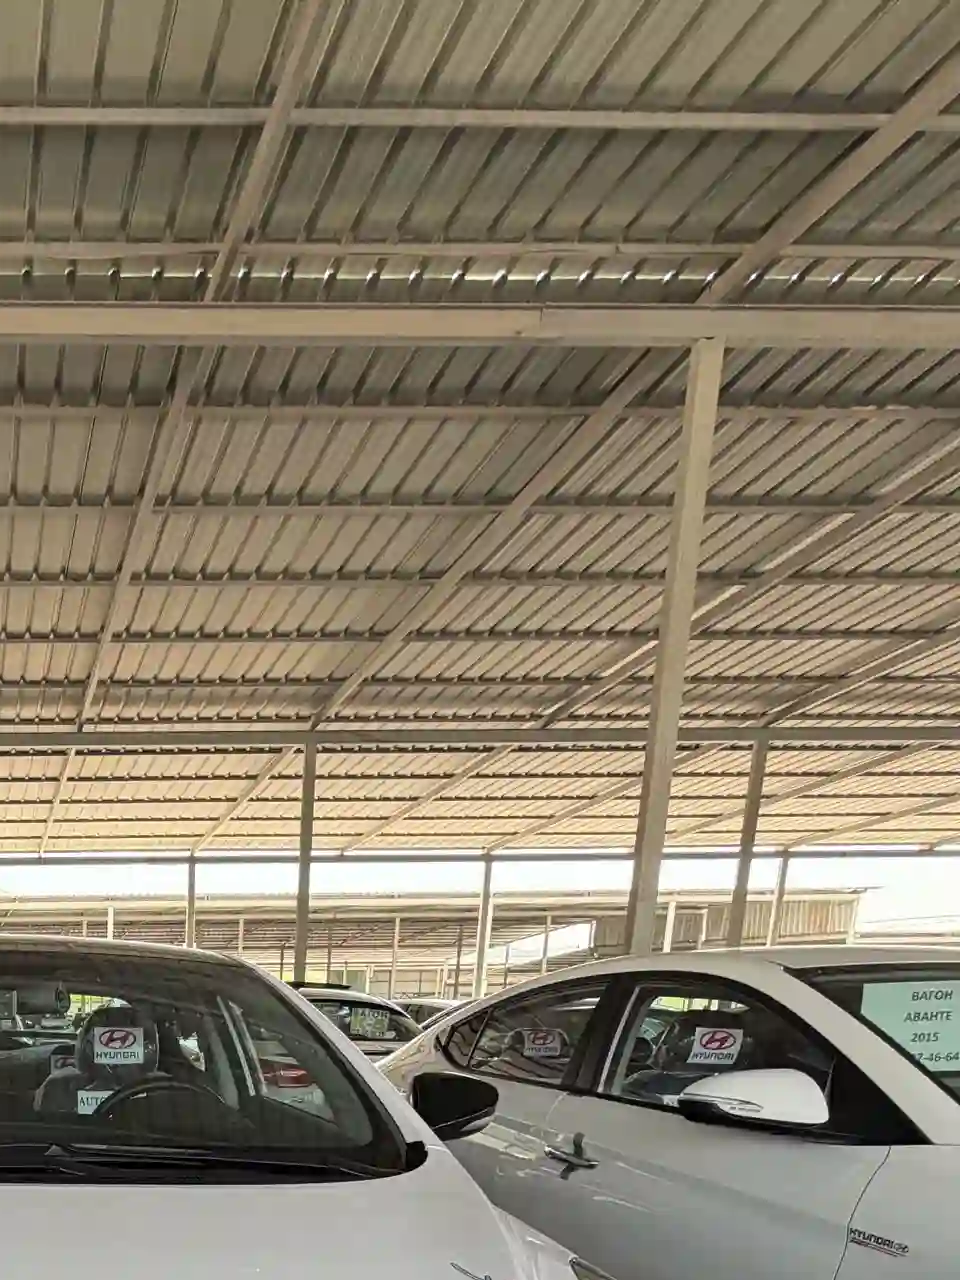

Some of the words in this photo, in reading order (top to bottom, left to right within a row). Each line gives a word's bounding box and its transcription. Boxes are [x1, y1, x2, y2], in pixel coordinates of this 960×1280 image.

[911, 990, 953, 1001] ВАГОН
[903, 1011, 953, 1023] АВАНТЕ
[910, 1032, 940, 1043] 2015
[95, 1050, 140, 1060] HYUNDAI
[692, 1051, 735, 1061] HYUNDAI
